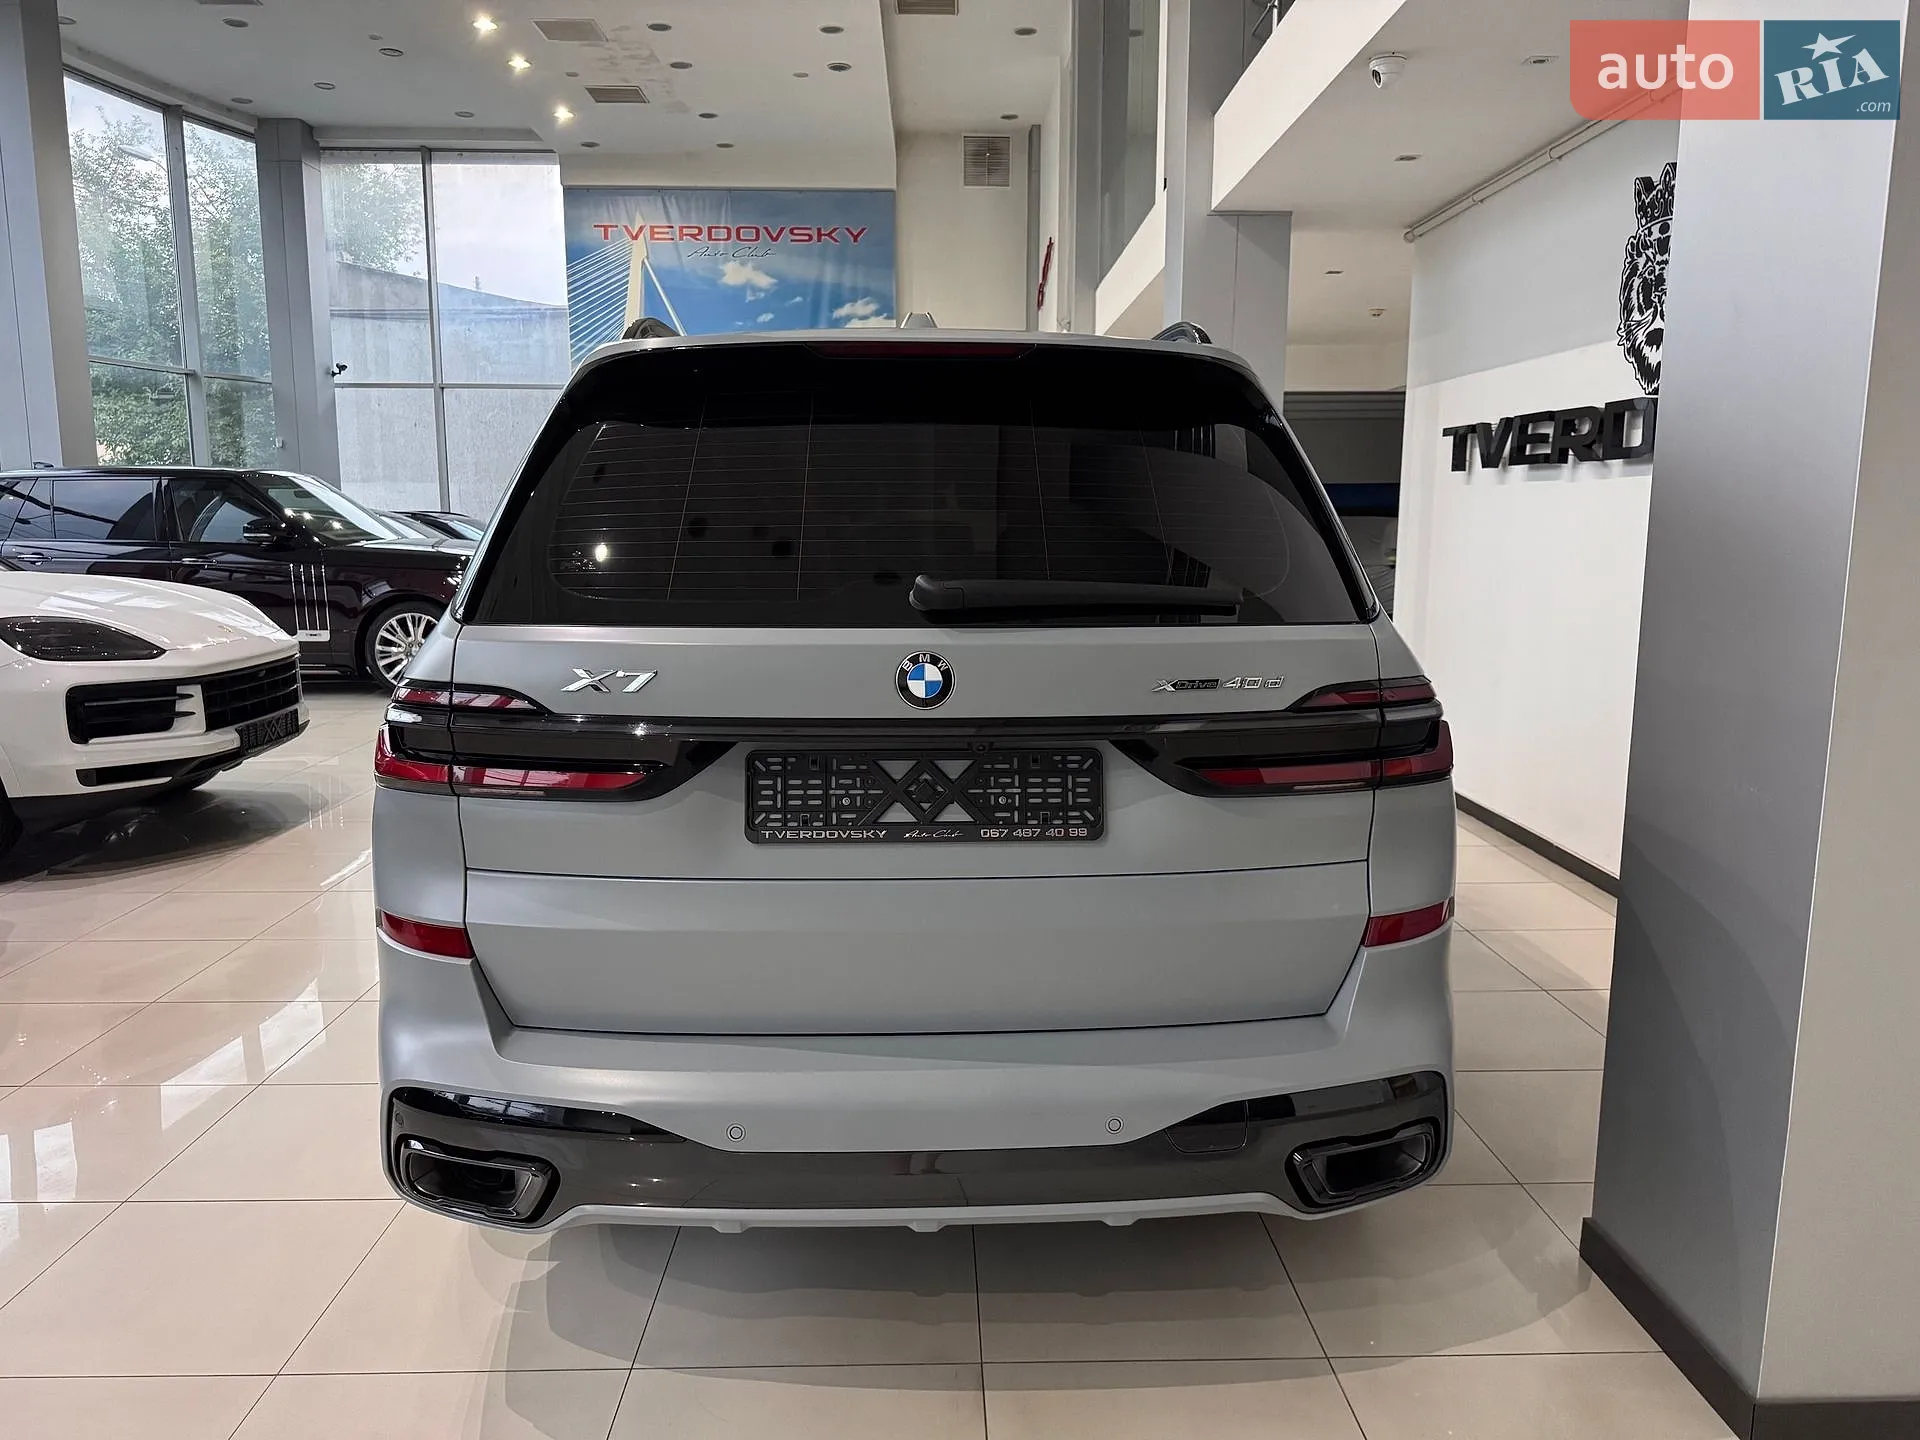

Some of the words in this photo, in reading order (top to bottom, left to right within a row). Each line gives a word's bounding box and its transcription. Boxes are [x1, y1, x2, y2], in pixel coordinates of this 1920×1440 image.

[593, 223, 868, 244] TVERDOVSKY
[687, 246, 728, 258] Auto
[731, 246, 776, 258] Club
[901, 653, 949, 672] BMW
[560, 668, 658, 692] X7
[761, 830, 887, 839] TVERDOVSKY
[980, 828, 1009, 838] 067
[1012, 828, 1041, 838] 487
[1045, 828, 1064, 837] 40
[1069, 827, 1088, 837] 99
